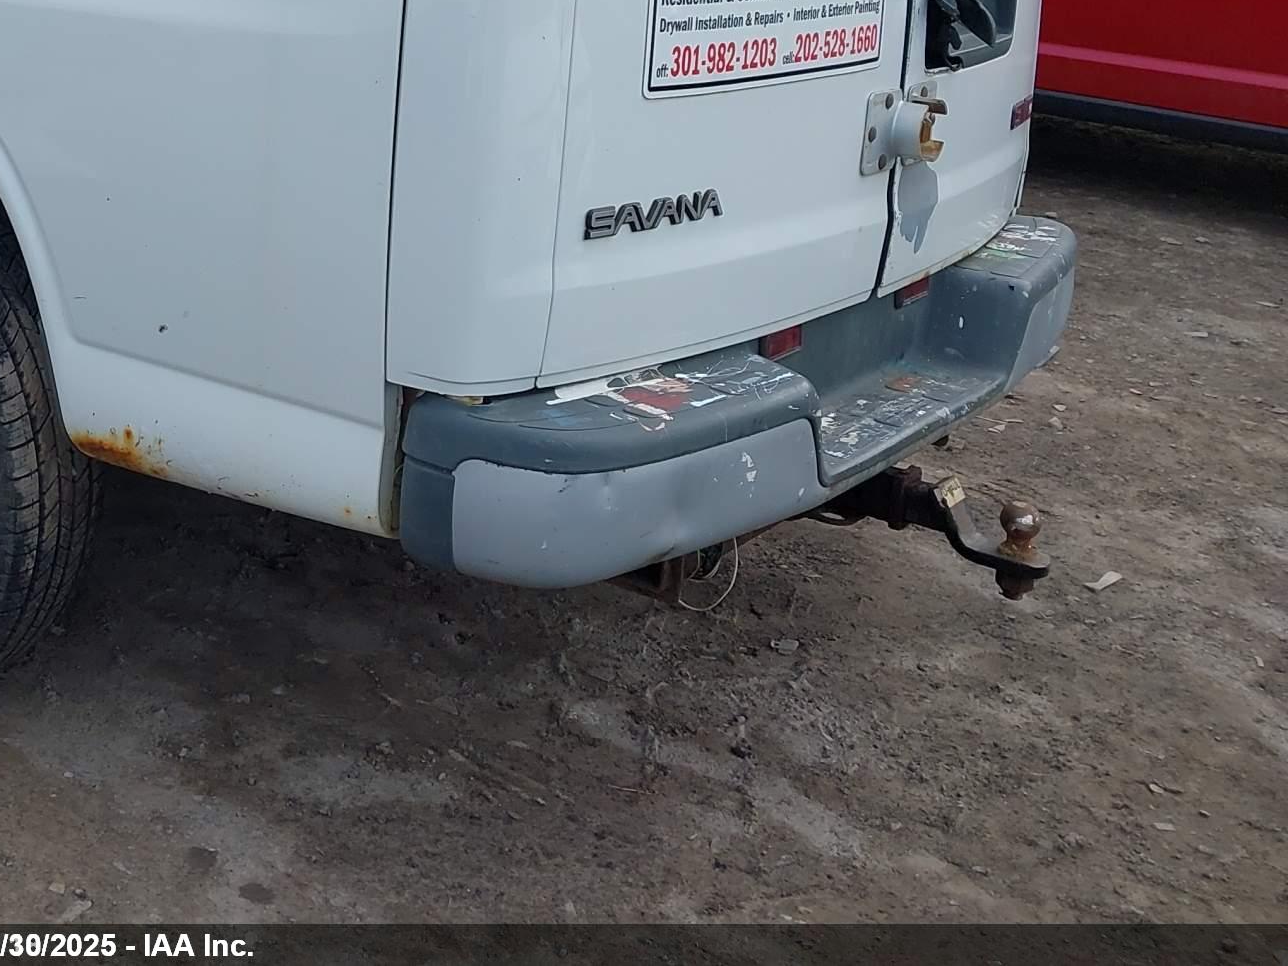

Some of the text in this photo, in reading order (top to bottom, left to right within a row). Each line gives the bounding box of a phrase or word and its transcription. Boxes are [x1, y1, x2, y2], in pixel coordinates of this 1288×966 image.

[660, 0, 880, 35] Drywall Installation & Repairs Interior & Exterior Painting
[671, 38, 776, 77] 301-982-1203
[782, 52, 795, 65] cell:
[795, 24, 877, 62] 202-528-1660
[584, 189, 723, 239] SAVANA
